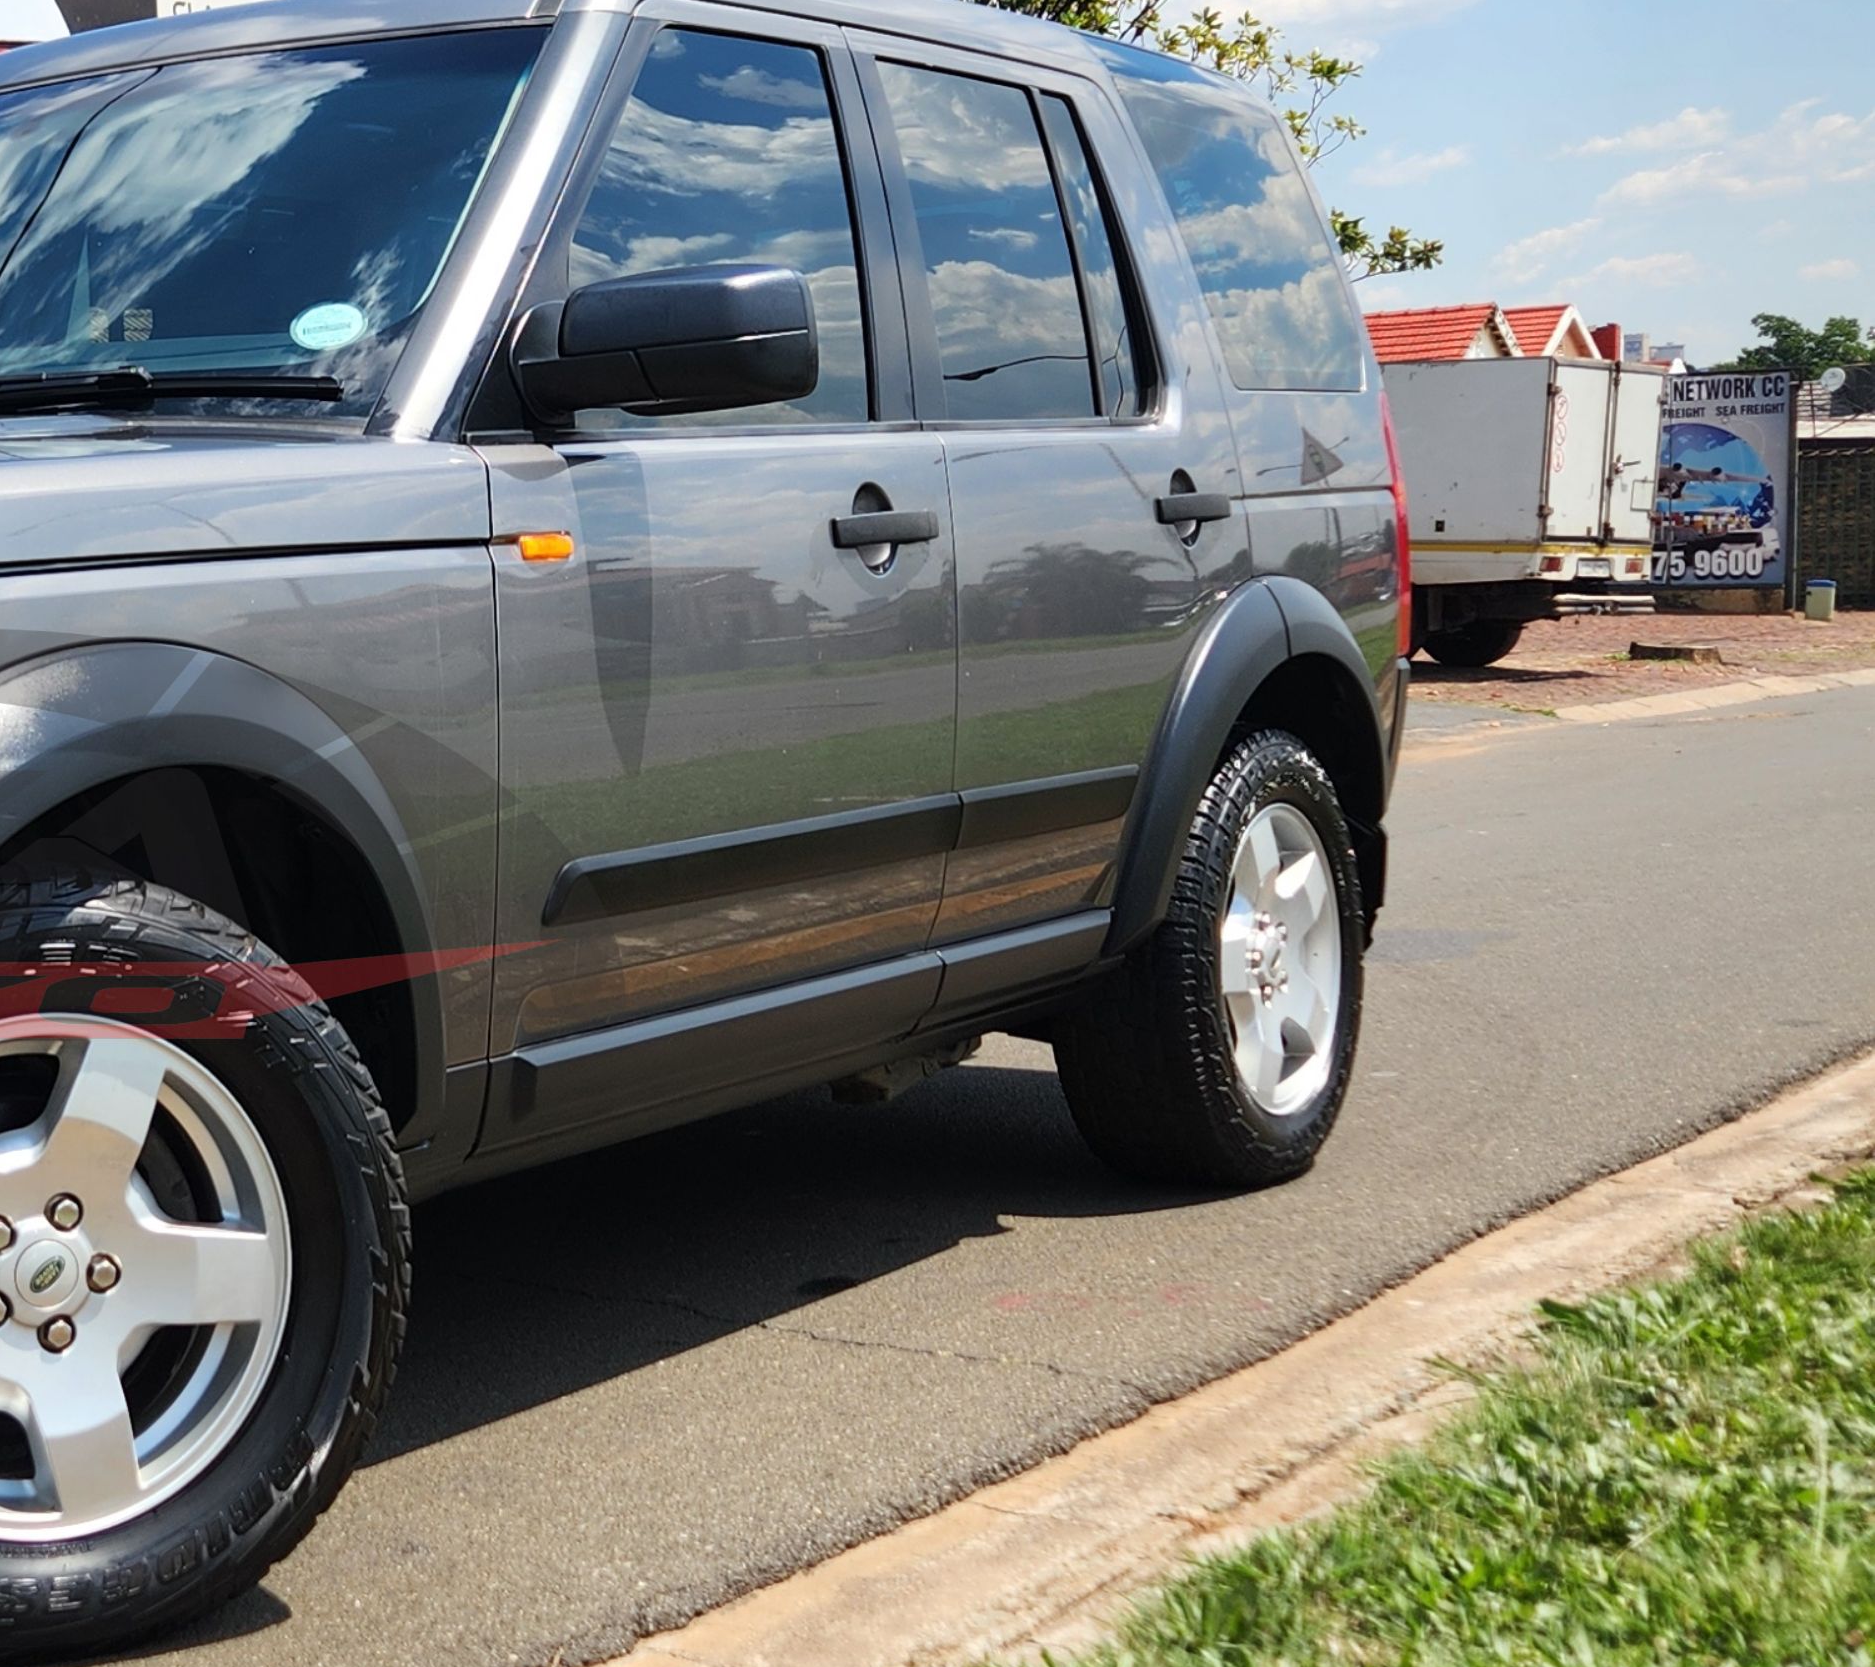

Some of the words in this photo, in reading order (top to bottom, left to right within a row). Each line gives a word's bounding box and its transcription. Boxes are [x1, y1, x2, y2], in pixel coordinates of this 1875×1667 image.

[1673, 377, 1756, 402] NETWORK
[1762, 375, 1785, 397] CC
[1662, 407, 1706, 418] FREIGHT
[1715, 405, 1737, 417] SEA
[1740, 403, 1785, 415] FREIGHT
[1652, 551, 1685, 577] 75
[1694, 550, 1763, 577] 9600
